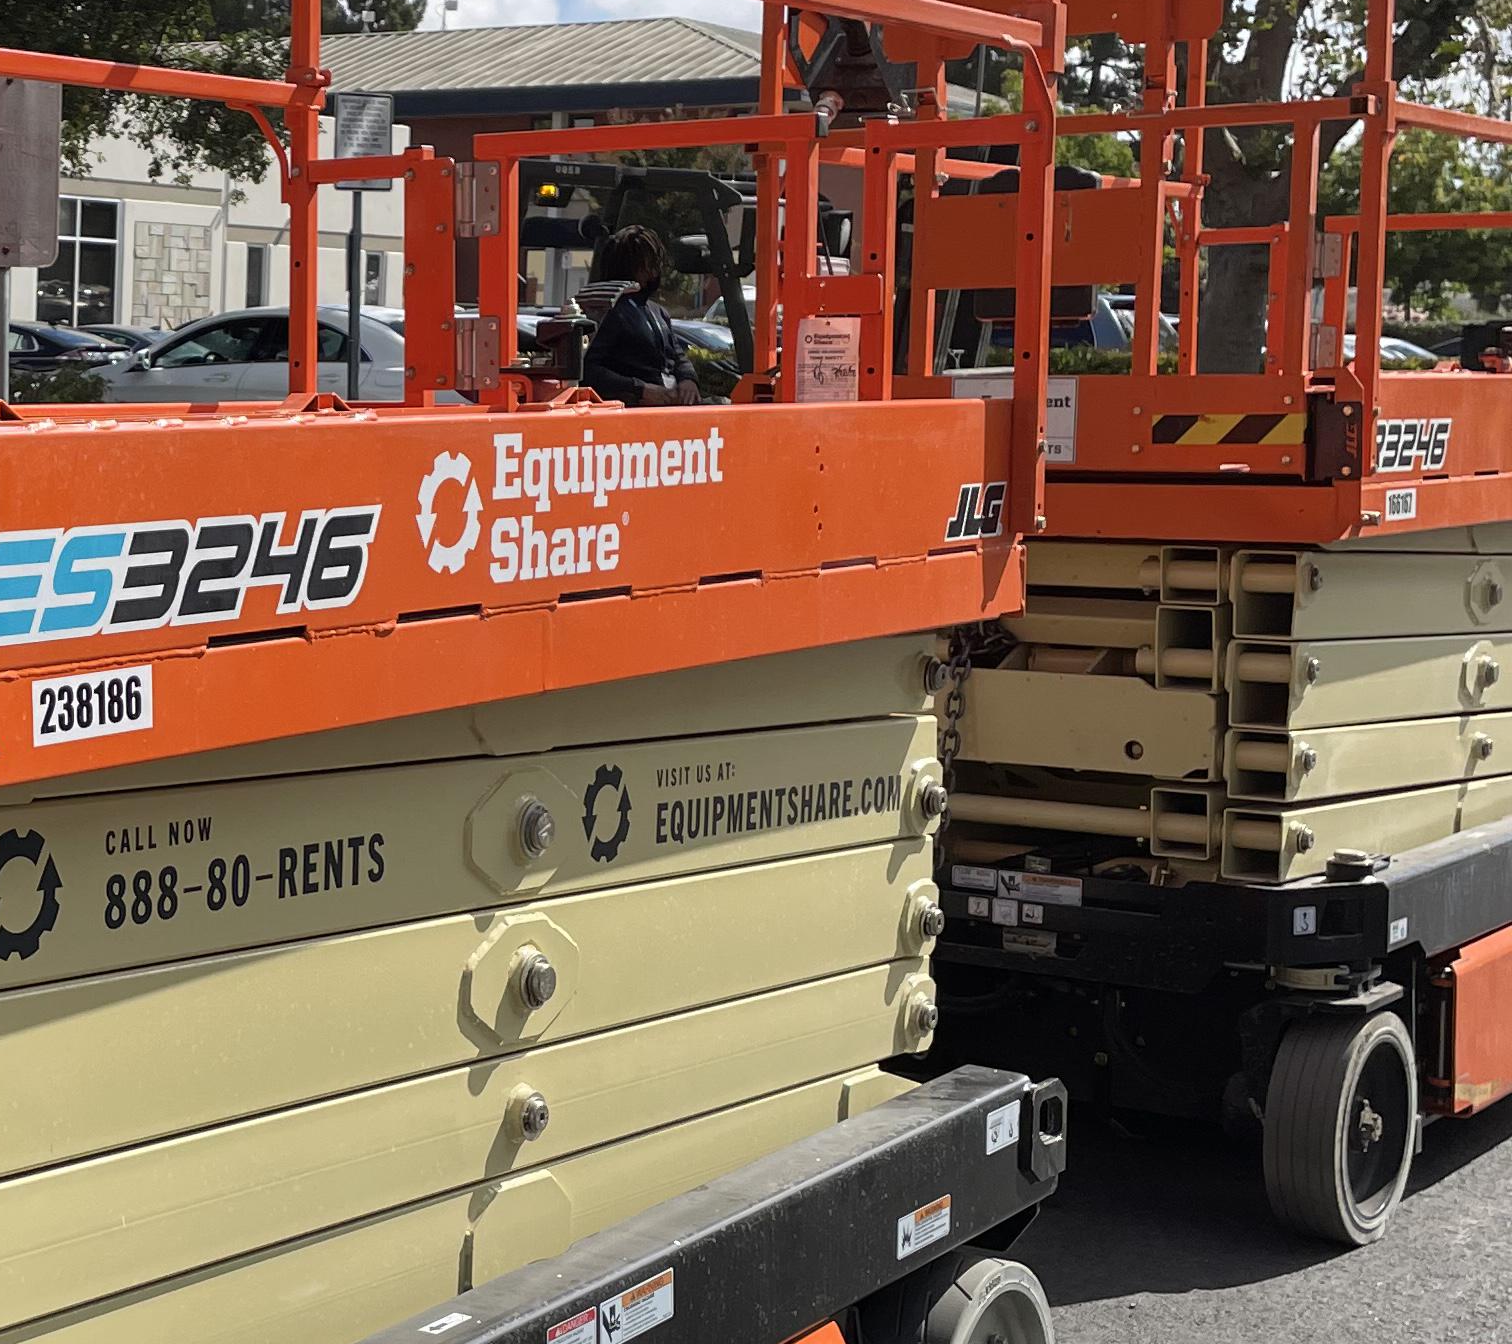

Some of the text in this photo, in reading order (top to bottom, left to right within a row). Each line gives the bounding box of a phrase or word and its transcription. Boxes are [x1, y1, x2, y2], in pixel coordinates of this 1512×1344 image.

[492, 426, 724, 512] Equipment
[945, 481, 1008, 543] JLG
[489, 515, 620, 583] Share
[39, 674, 143, 735] 238186
[656, 761, 736, 788] VISIT US AT:
[105, 816, 212, 856] CALL NOW
[655, 774, 902, 844] EQUIPMENTSHARE.COM
[104, 833, 385, 930] 888-80-RENTS
